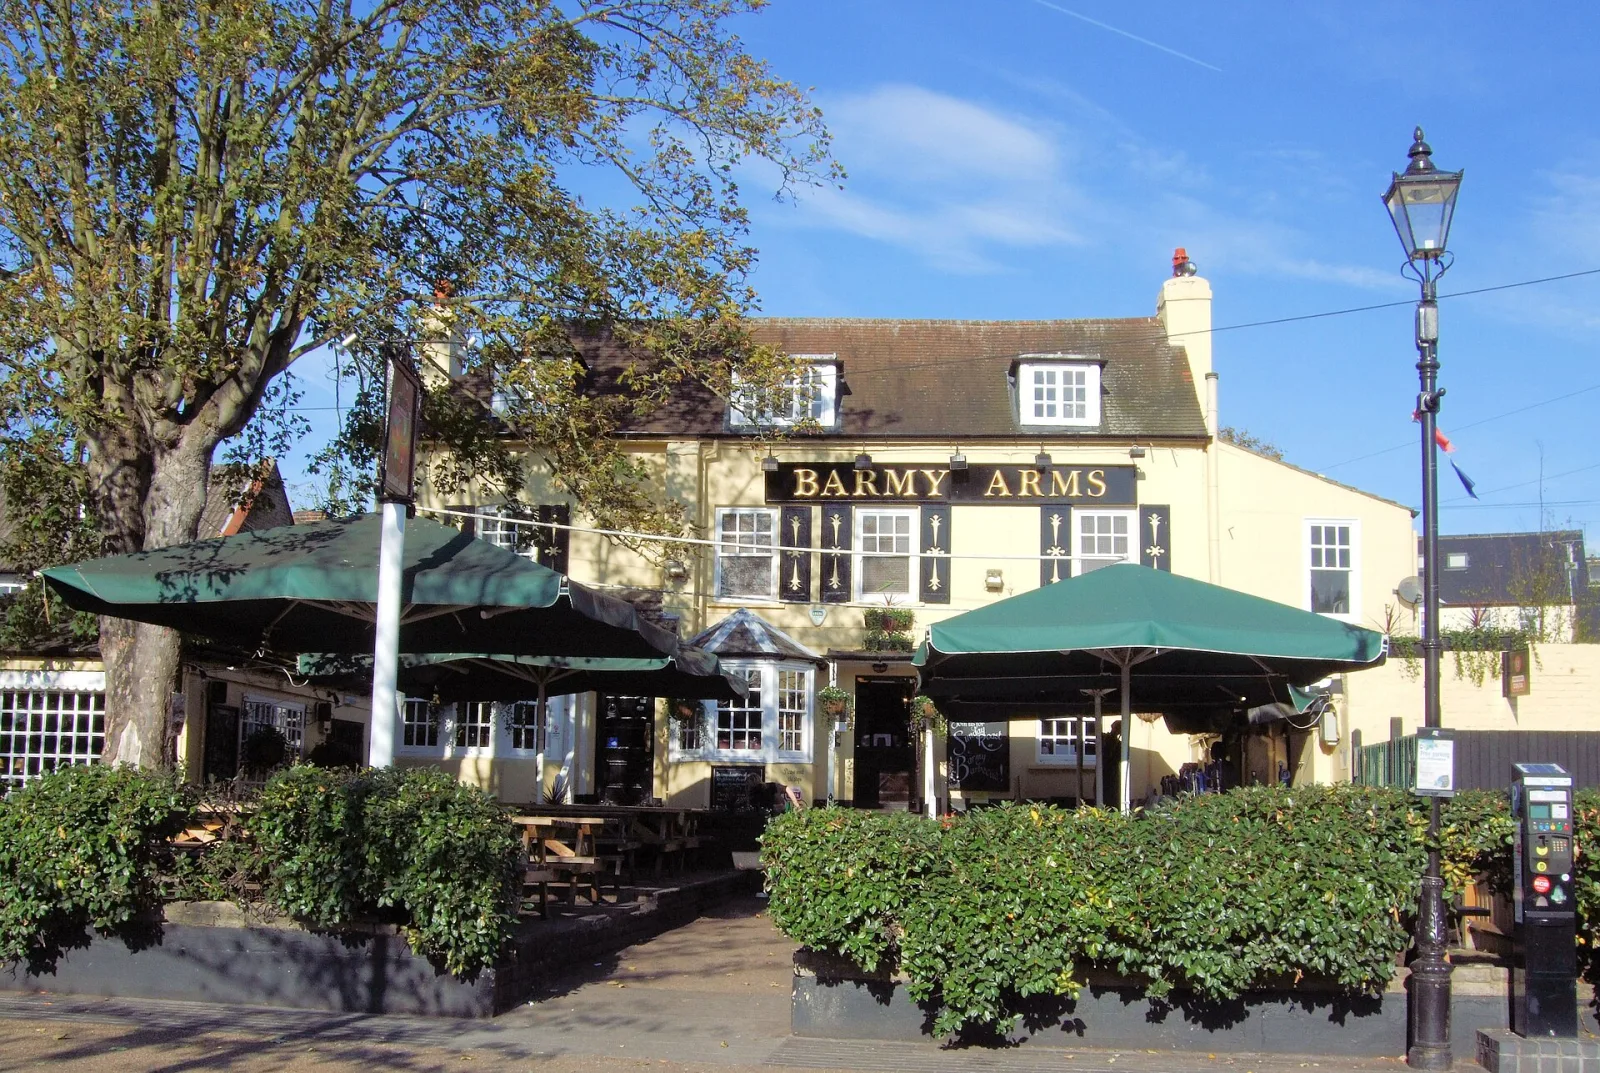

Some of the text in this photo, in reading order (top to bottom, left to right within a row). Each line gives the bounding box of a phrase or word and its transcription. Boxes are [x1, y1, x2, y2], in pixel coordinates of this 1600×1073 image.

[793, 468, 1108, 498] BARMY ARMS
[953, 727, 986, 755] Sunday
[976, 730, 1003, 752] Roast
